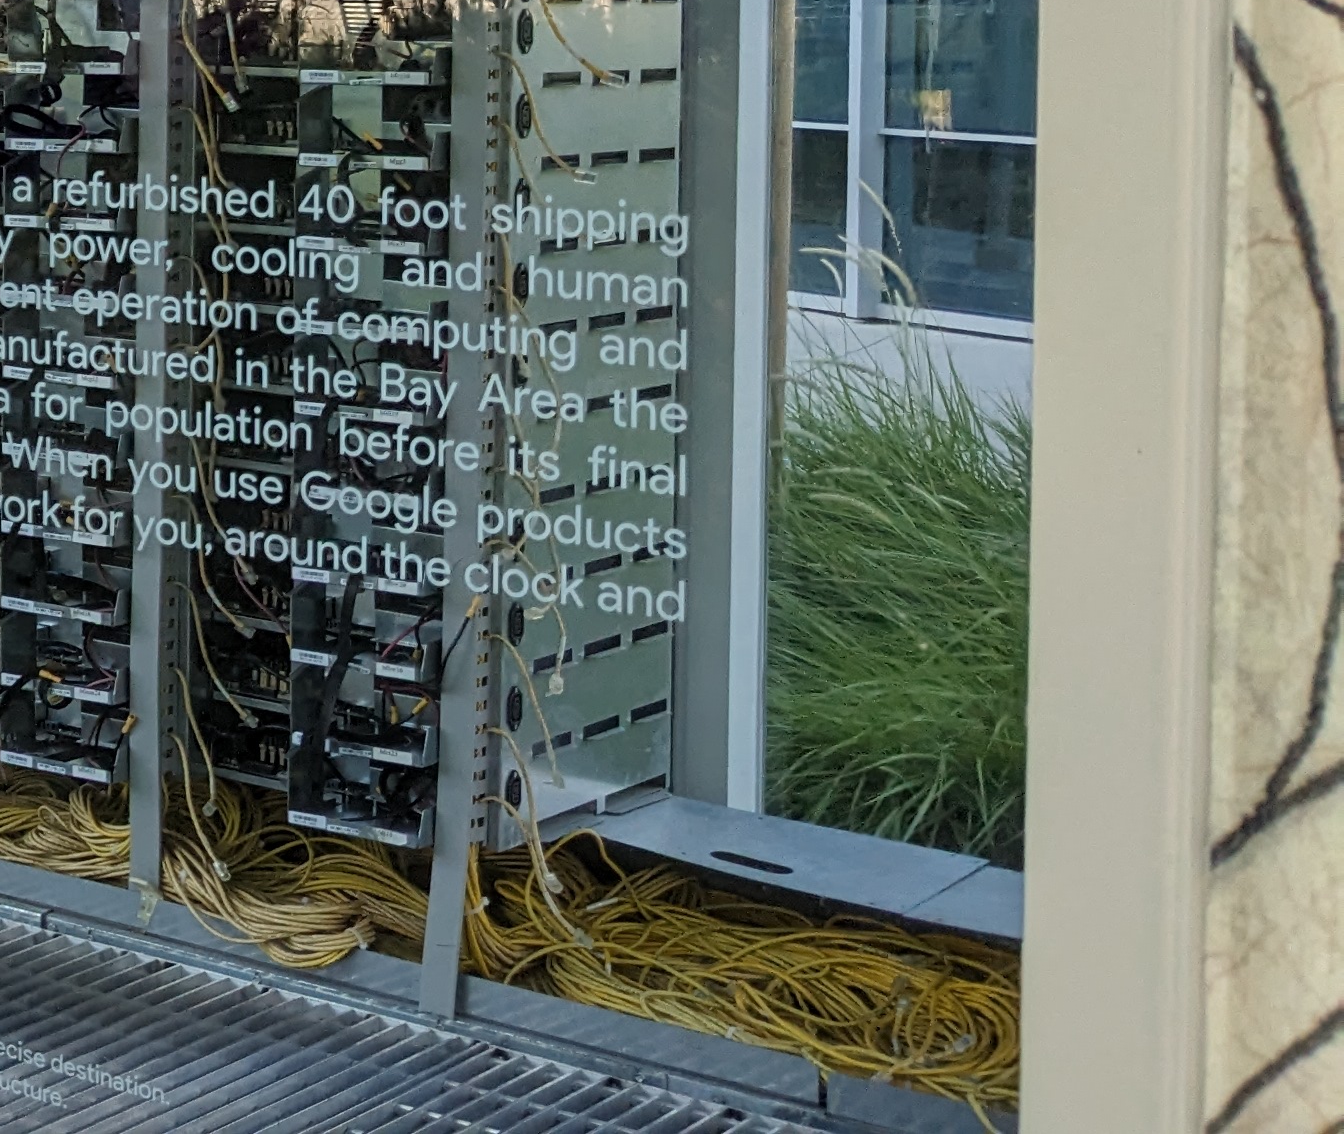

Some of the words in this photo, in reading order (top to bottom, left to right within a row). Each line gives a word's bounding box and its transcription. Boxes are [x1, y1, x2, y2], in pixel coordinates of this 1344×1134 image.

[12, 175, 32, 203] a
[53, 170, 274, 218] refurbished
[298, 184, 354, 224] 40
[378, 186, 466, 231] foot
[491, 194, 689, 257] shipping
[50, 231, 174, 271] power,
[212, 238, 359, 293] cooling
[402, 252, 482, 291] and
[528, 255, 688, 307] human
[72, 287, 257, 331] operation
[276, 297, 319, 335] of
[337, 311, 577, 372] computing
[599, 329, 687, 370] and
[235, 347, 268, 389] in
[290, 355, 357, 398] the
[380, 362, 458, 419] Bay
[478, 373, 584, 422] Area
[609, 387, 688, 433] the
[30, 381, 83, 422] for
[105, 399, 312, 451] population
[340, 417, 480, 471] before
[508, 436, 560, 481] its
[587, 445, 686, 497] final
[6, 431, 112, 482] When
[128, 458, 196, 494] you
[214, 469, 283, 504] use
[300, 470, 457, 534] Google
[477, 503, 687, 559] products
[70, 495, 124, 536] for
[134, 514, 212, 556] you,
[224, 527, 368, 575] around
[380, 541, 451, 586] the
[464, 554, 584, 609] clock
[597, 580, 685, 622] and
[50, 1053, 170, 1106] destination.
